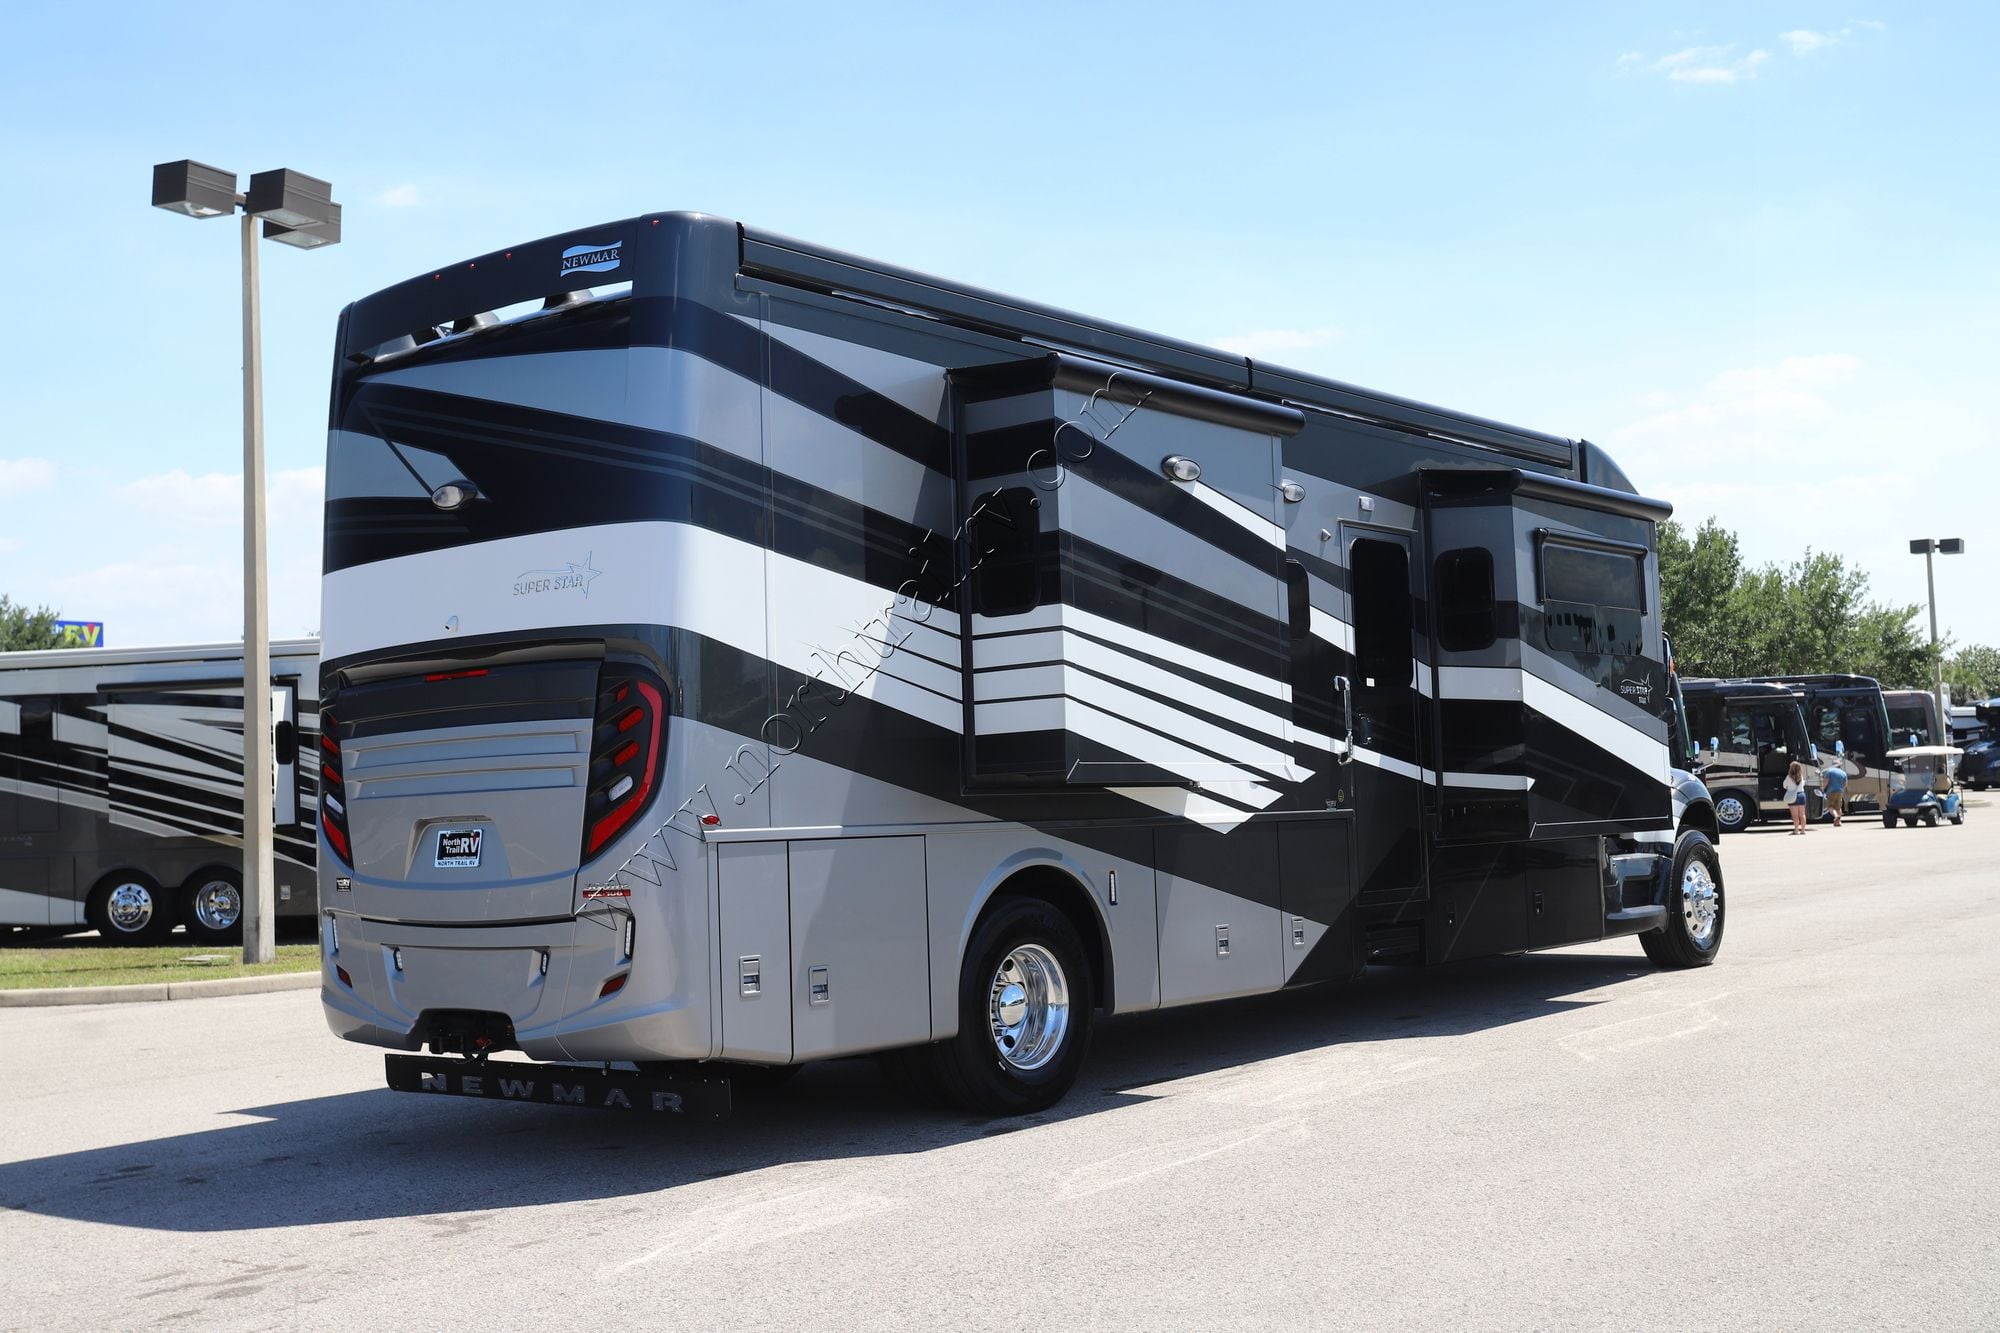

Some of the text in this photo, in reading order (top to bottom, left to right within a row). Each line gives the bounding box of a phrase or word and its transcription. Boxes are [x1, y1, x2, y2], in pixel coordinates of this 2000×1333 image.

[562, 249, 619, 269] NEWMAR
[513, 574, 583, 596] SUPER STAR
[64, 625, 100, 646] RV
[443, 838, 460, 846] North
[446, 846, 460, 854] Trail
[460, 837, 479, 853] RV
[421, 1072, 685, 1113] NEWMAR
